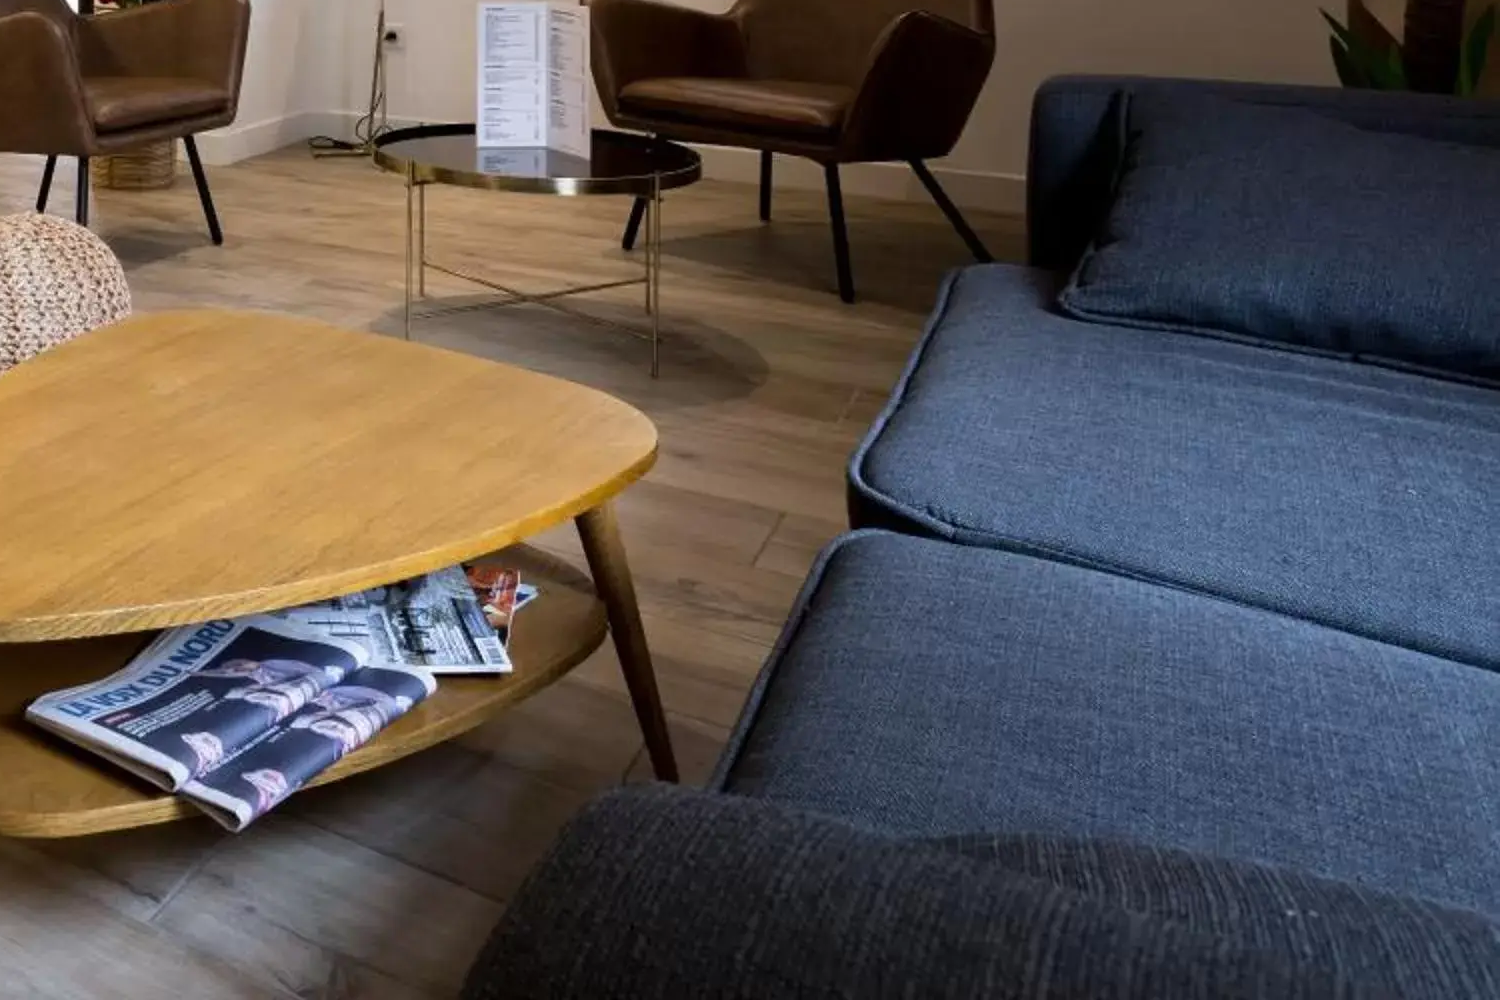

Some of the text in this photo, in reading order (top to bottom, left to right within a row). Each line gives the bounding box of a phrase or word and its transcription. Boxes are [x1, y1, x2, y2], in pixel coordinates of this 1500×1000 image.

[56, 701, 100, 718] LA
[137, 664, 182, 686] DU
[168, 619, 235, 665] NORD
